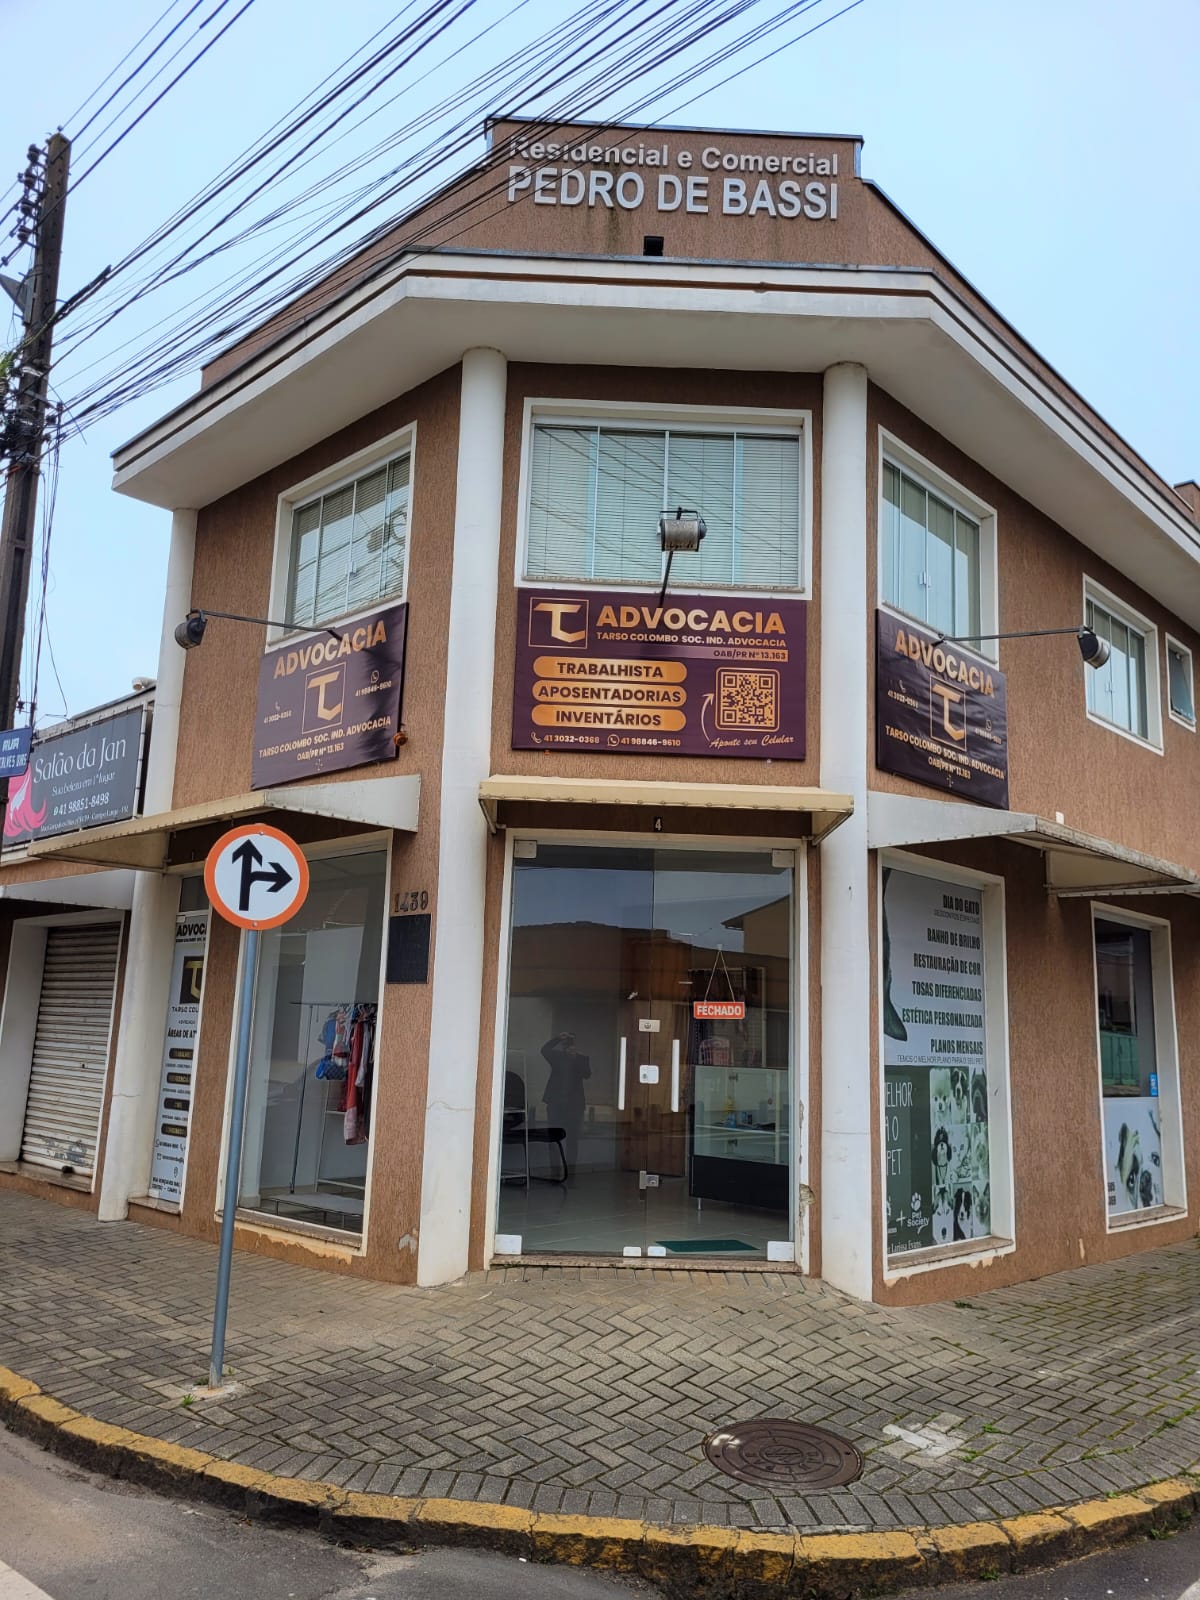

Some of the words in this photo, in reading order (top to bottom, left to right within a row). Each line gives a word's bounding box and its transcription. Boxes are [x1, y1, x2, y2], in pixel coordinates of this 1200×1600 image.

[509, 136, 668, 167] Residencial
[677, 152, 692, 168] e
[702, 148, 838, 176] Comercial
[508, 166, 645, 210] PEDRO
[658, 175, 709, 214] DE
[722, 178, 838, 220] BASSI
[596, 605, 786, 635] ADVOCACIA
[273, 620, 386, 680] ADVOCACIA
[597, 632, 628, 641] TARSO
[630, 633, 678, 643] COLOMBO
[682, 635, 704, 644] SOC.
[706, 636, 725, 645] IND.
[728, 637, 786, 648] ADVOCACIA
[713, 649, 747, 658] OAB/PR
[895, 629, 994, 698] ADVOCACIA
[557, 662, 664, 678] TRABALHISTA
[538, 686, 681, 703] APOSENTADORIAS
[556, 709, 661, 727] INVENTÁRIOS
[259, 746, 280, 759] TARSO
[280, 737, 312, 753] COLOMBO
[346, 716, 391, 737] ADVOCACIA
[761, 735, 794, 746] Celular
[33, 752, 73, 783] Salão
[76, 742, 96, 770] da
[99, 737, 126, 771] Jan
[885, 725, 909, 743] TARSO
[909, 735, 942, 755] COLOMBO
[971, 760, 1004, 780] ADVOCACIA
[655, 819, 662, 831] 4
[927, 927, 949, 945] BANHO
[950, 932, 958, 946] DE
[913, 953, 959, 974] RESTAURAÇÃO
[960, 960, 968, 974] DE
[968, 961, 981, 976] COR
[912, 980, 934, 997] TOSAS
[935, 983, 982, 1002] DIFERENCIADAS
[696, 1005, 742, 1016] FECHADO
[902, 1006, 933, 1025] ESTÉTICA
[934, 1010, 983, 1028] PERSONALIZADA
[930, 1038, 955, 1054] PLANOS
[956, 1039, 983, 1055] MENSAIS
[891, 1115, 899, 1141] O
[886, 1149, 903, 1176] PET
